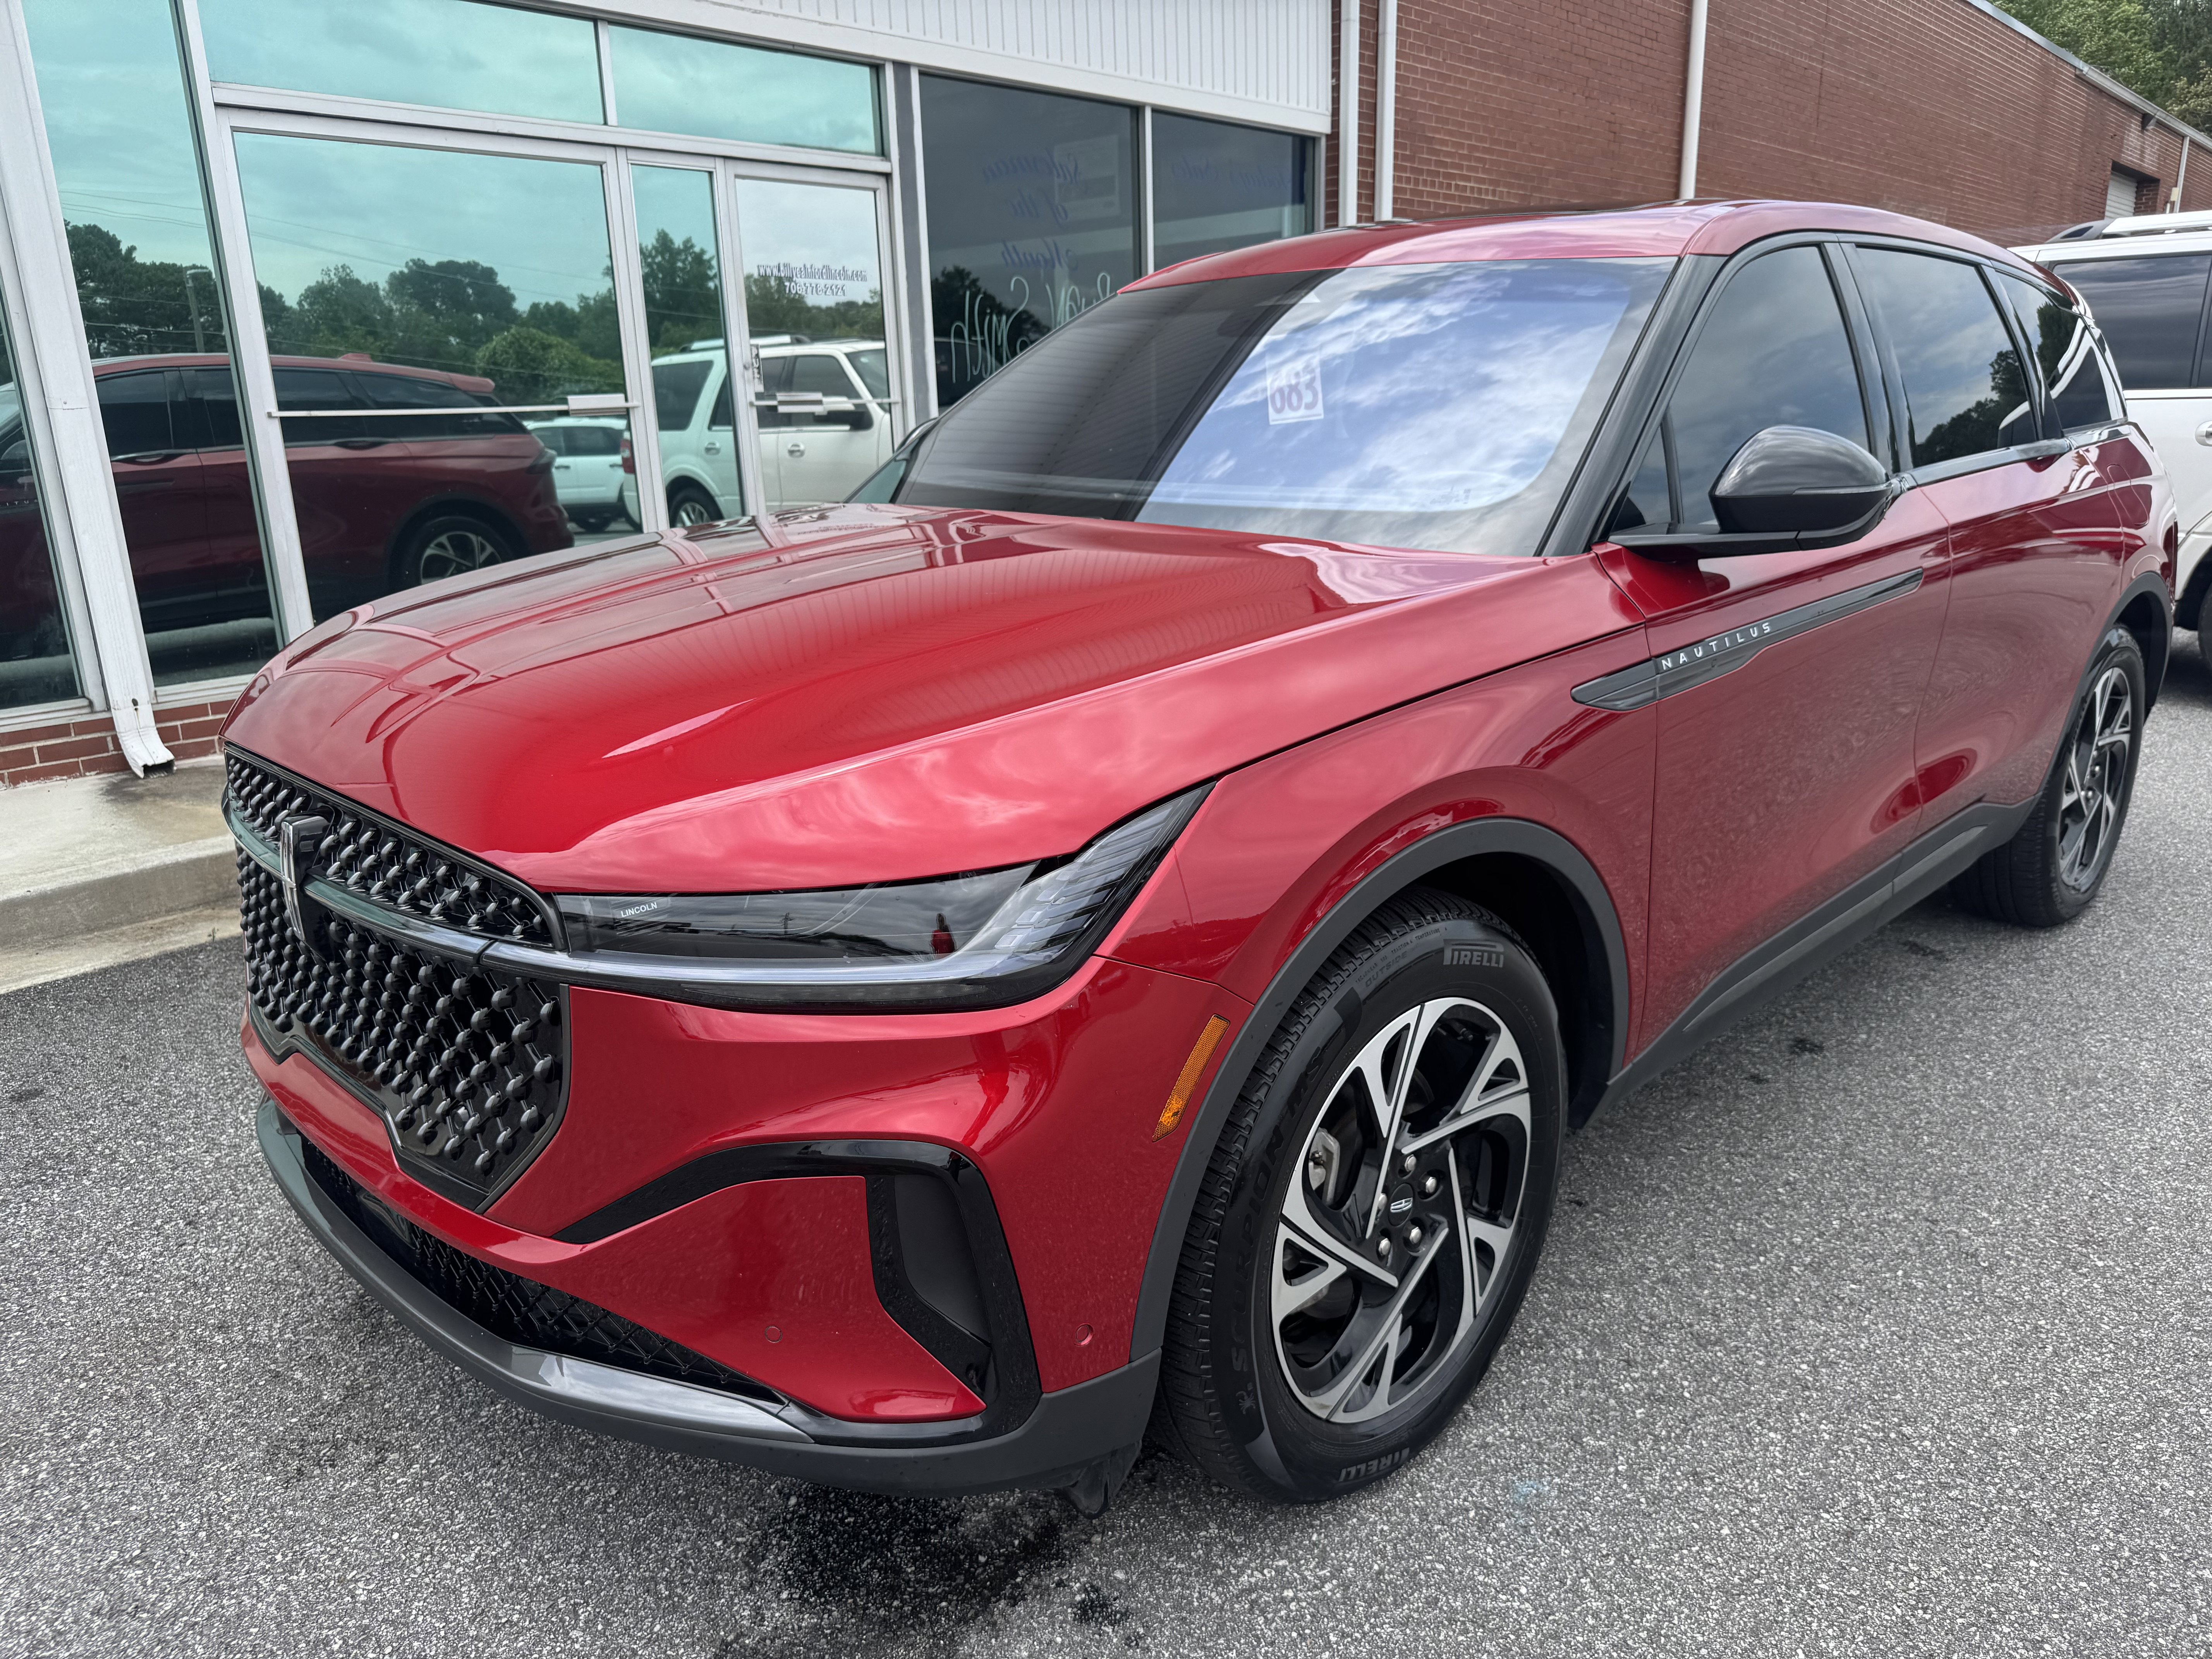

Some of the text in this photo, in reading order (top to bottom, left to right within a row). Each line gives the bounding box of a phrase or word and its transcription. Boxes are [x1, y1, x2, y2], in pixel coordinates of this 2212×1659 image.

[1661, 622, 1771, 670] NAUTILUS
[621, 902, 658, 917] LINCOLN
[1365, 951, 1407, 988] OUTSIDE
[1443, 939, 1504, 968] PIRELLI
[1231, 1125, 1284, 1372] SCORPION
